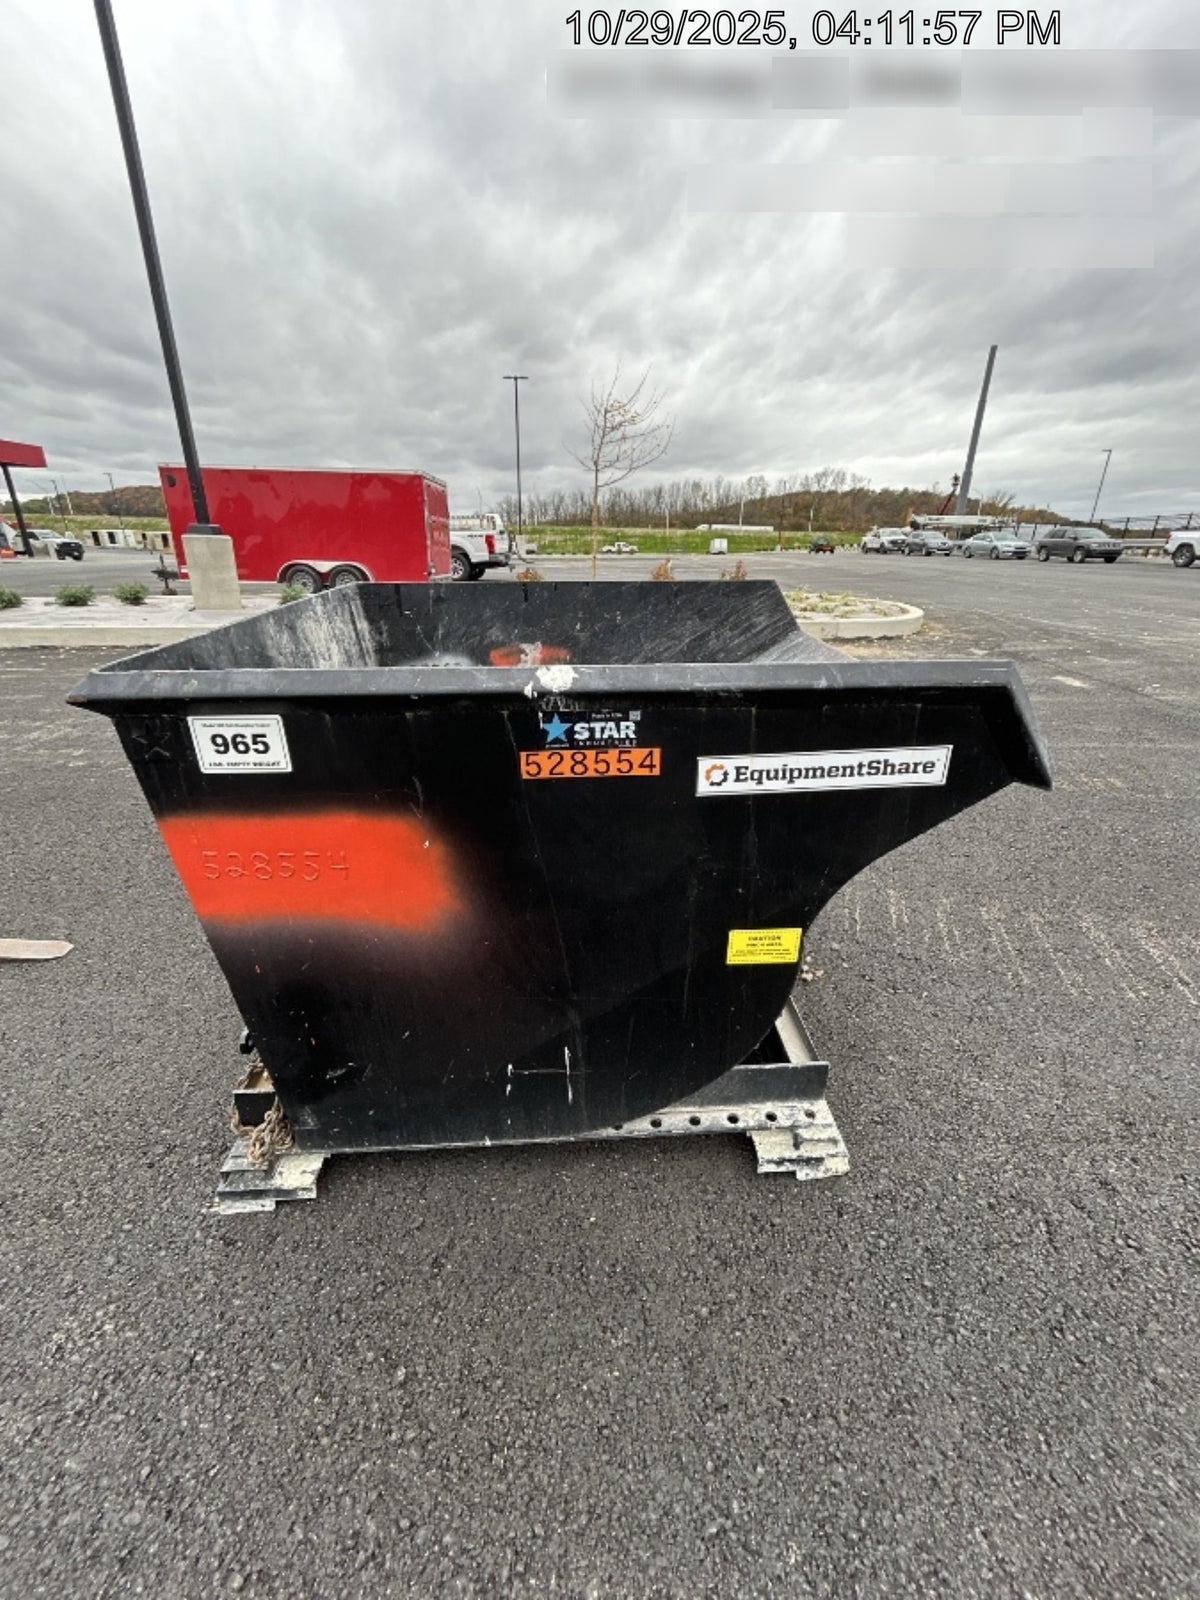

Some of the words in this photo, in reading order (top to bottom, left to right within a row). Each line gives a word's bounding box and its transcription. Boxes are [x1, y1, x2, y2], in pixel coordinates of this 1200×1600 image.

[574, 721, 637, 740] STAR
[210, 733, 271, 755] 965
[526, 750, 656, 777] 528554
[734, 759, 936, 785] EquipmentShare
[202, 851, 350, 880] 528554
